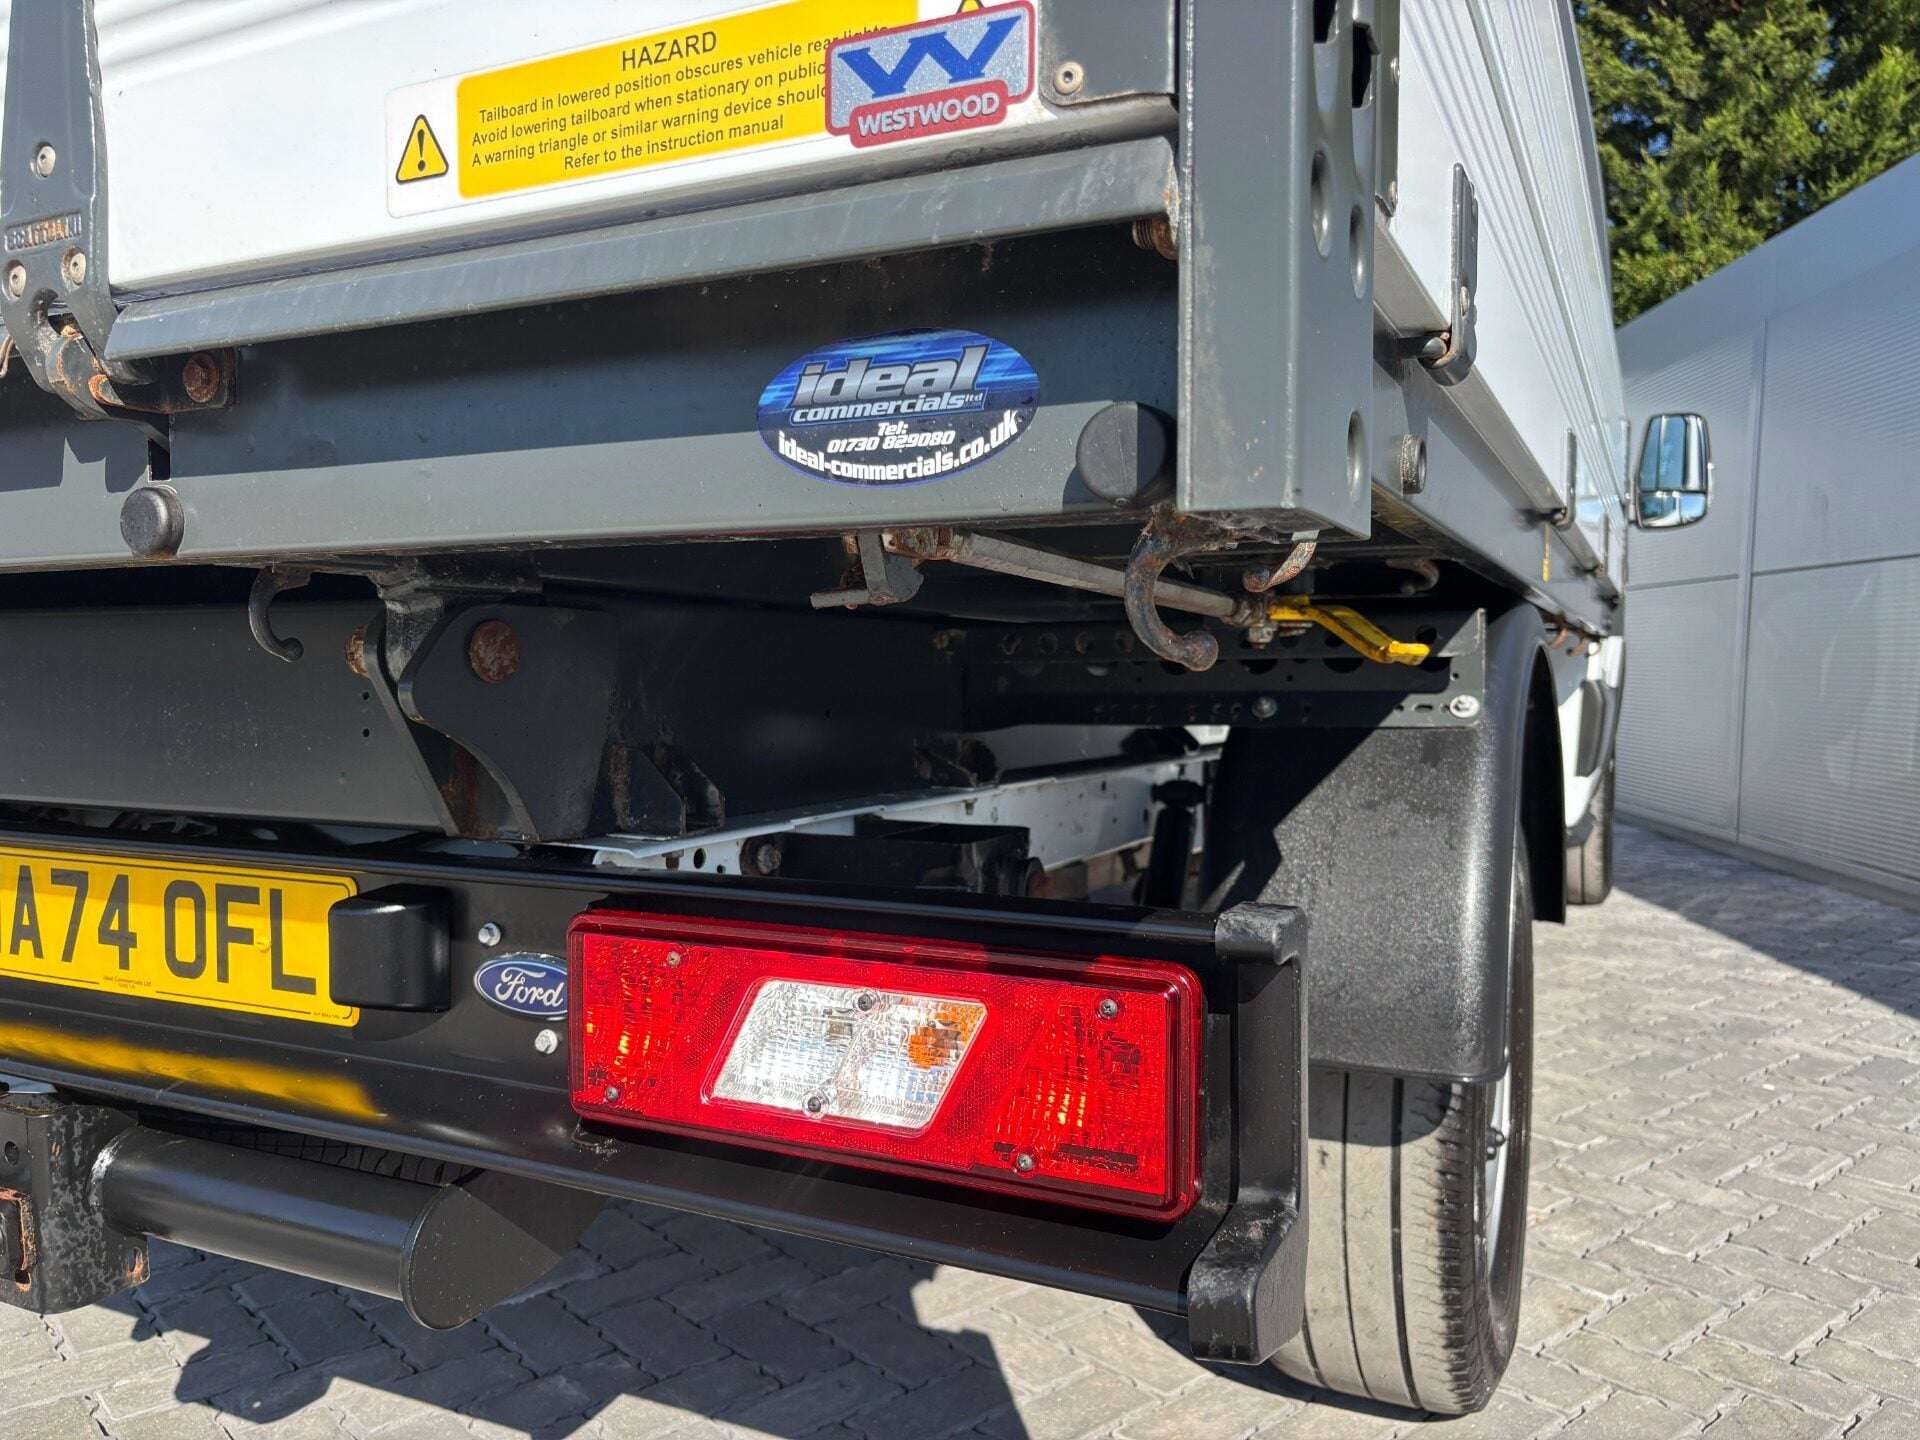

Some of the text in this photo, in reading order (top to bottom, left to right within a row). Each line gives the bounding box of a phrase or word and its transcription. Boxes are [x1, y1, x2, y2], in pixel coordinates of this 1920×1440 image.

[621, 31, 718, 72] HAZARD
[472, 61, 826, 147] Avoid lowering tailboard when stationary on public
[480, 36, 838, 124] Tailboard in lowered position obscures vehicle rea
[472, 153, 482, 168] A
[484, 145, 535, 164] warning
[538, 133, 589, 154] triangle
[592, 131, 607, 144] or
[610, 119, 658, 140] similar
[661, 108, 719, 128] warning
[724, 97, 772, 117] device
[564, 114, 784, 170] Refer to the instruction manual
[857, 92, 1000, 138] WESTWOOD
[791, 344, 990, 406] ideal
[793, 391, 966, 423] commercials
[878, 421, 908, 437] Tel:
[778, 409, 1019, 481] ideal-commercials.co.uk
[827, 431, 956, 453] 01730 829080
[0, 864, 317, 996] A74 OFL
[495, 966, 565, 1007] Ford
